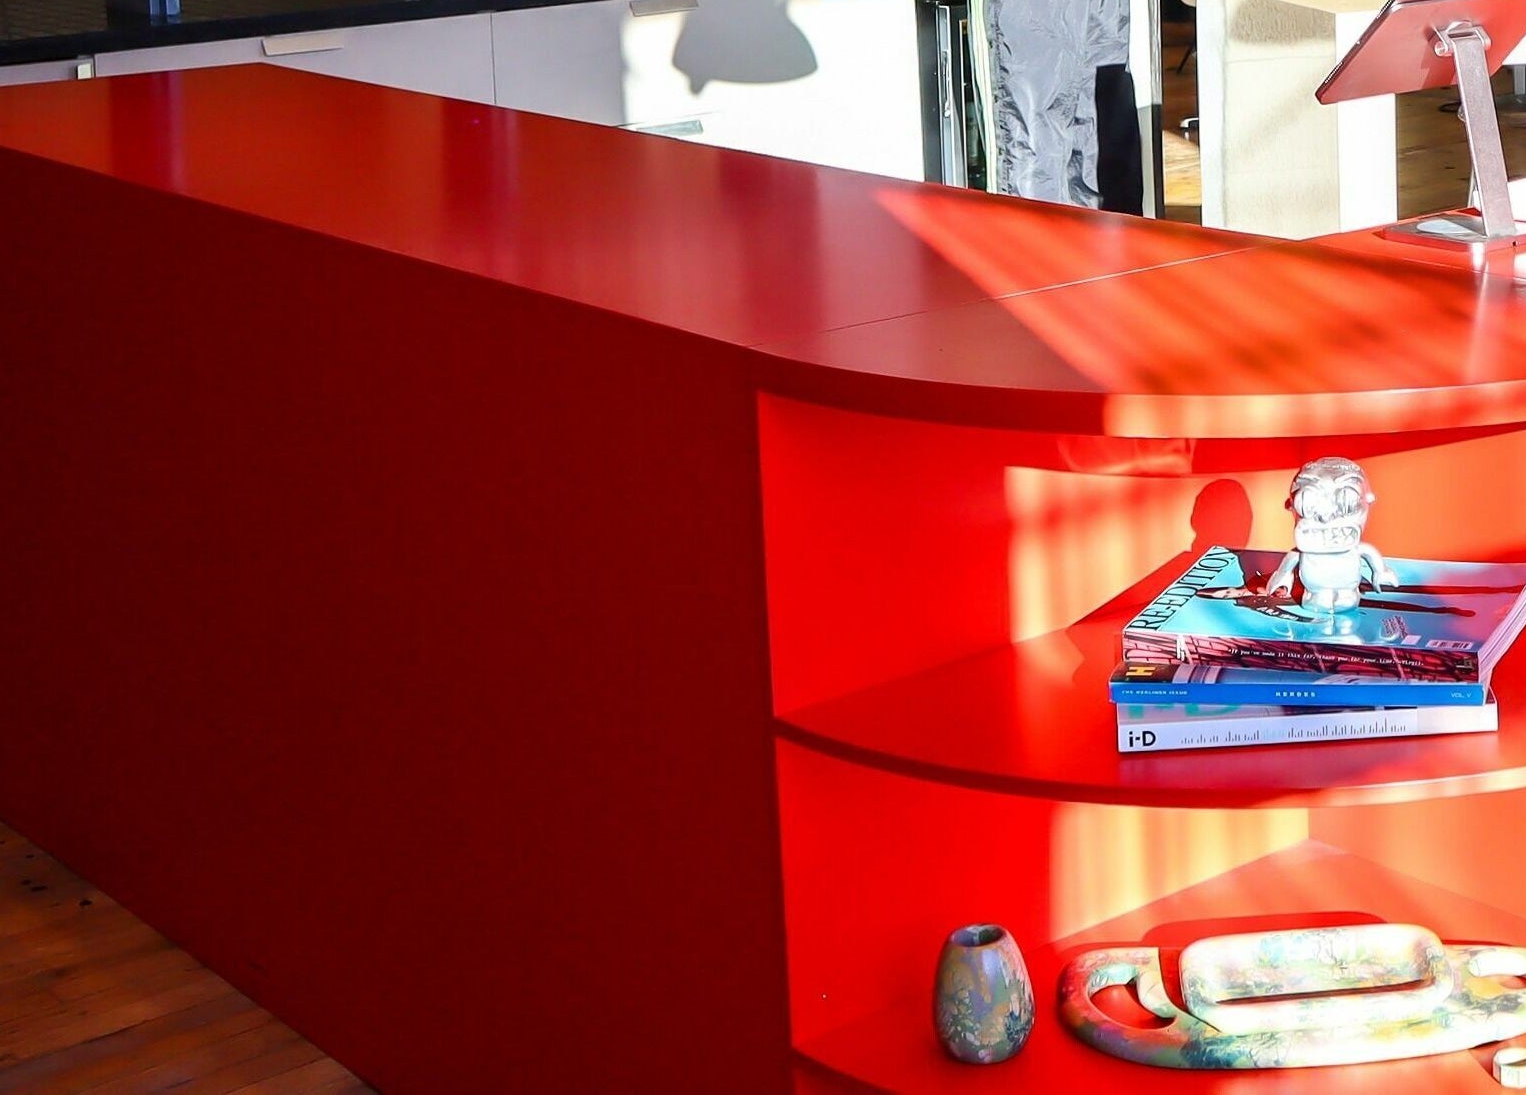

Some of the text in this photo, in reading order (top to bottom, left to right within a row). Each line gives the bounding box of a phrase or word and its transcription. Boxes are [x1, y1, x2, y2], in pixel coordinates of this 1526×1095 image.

[1126, 546, 1236, 632] RE-EDITION
[1126, 667, 1156, 676] H
[1128, 730, 1157, 748] i-D
